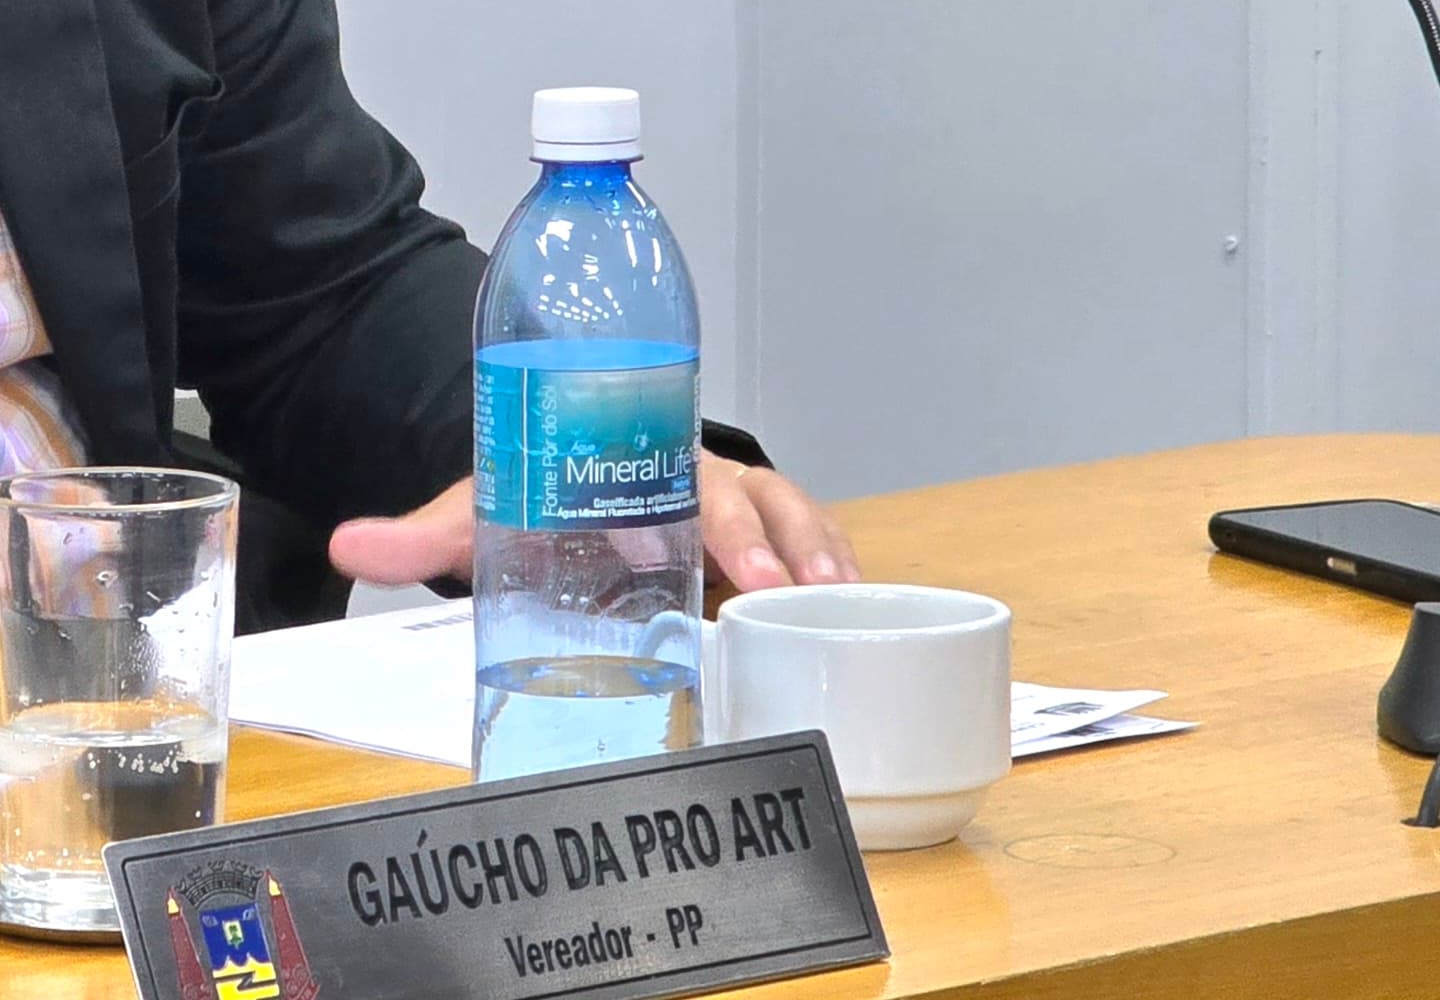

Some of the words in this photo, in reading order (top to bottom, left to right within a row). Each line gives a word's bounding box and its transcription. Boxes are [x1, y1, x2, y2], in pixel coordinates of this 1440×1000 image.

[541, 385, 558, 411] Sol
[541, 414, 558, 437] do
[541, 438, 559, 468] Por
[566, 450, 659, 484] Mineral
[663, 446, 691, 479] Life
[541, 471, 559, 518] Fonte
[346, 830, 548, 927] GAÚCHO
[553, 821, 628, 892] DA
[625, 804, 721, 878] PRO
[732, 787, 813, 862] ART
[504, 922, 635, 977] Vereador
[665, 904, 704, 949] PP
